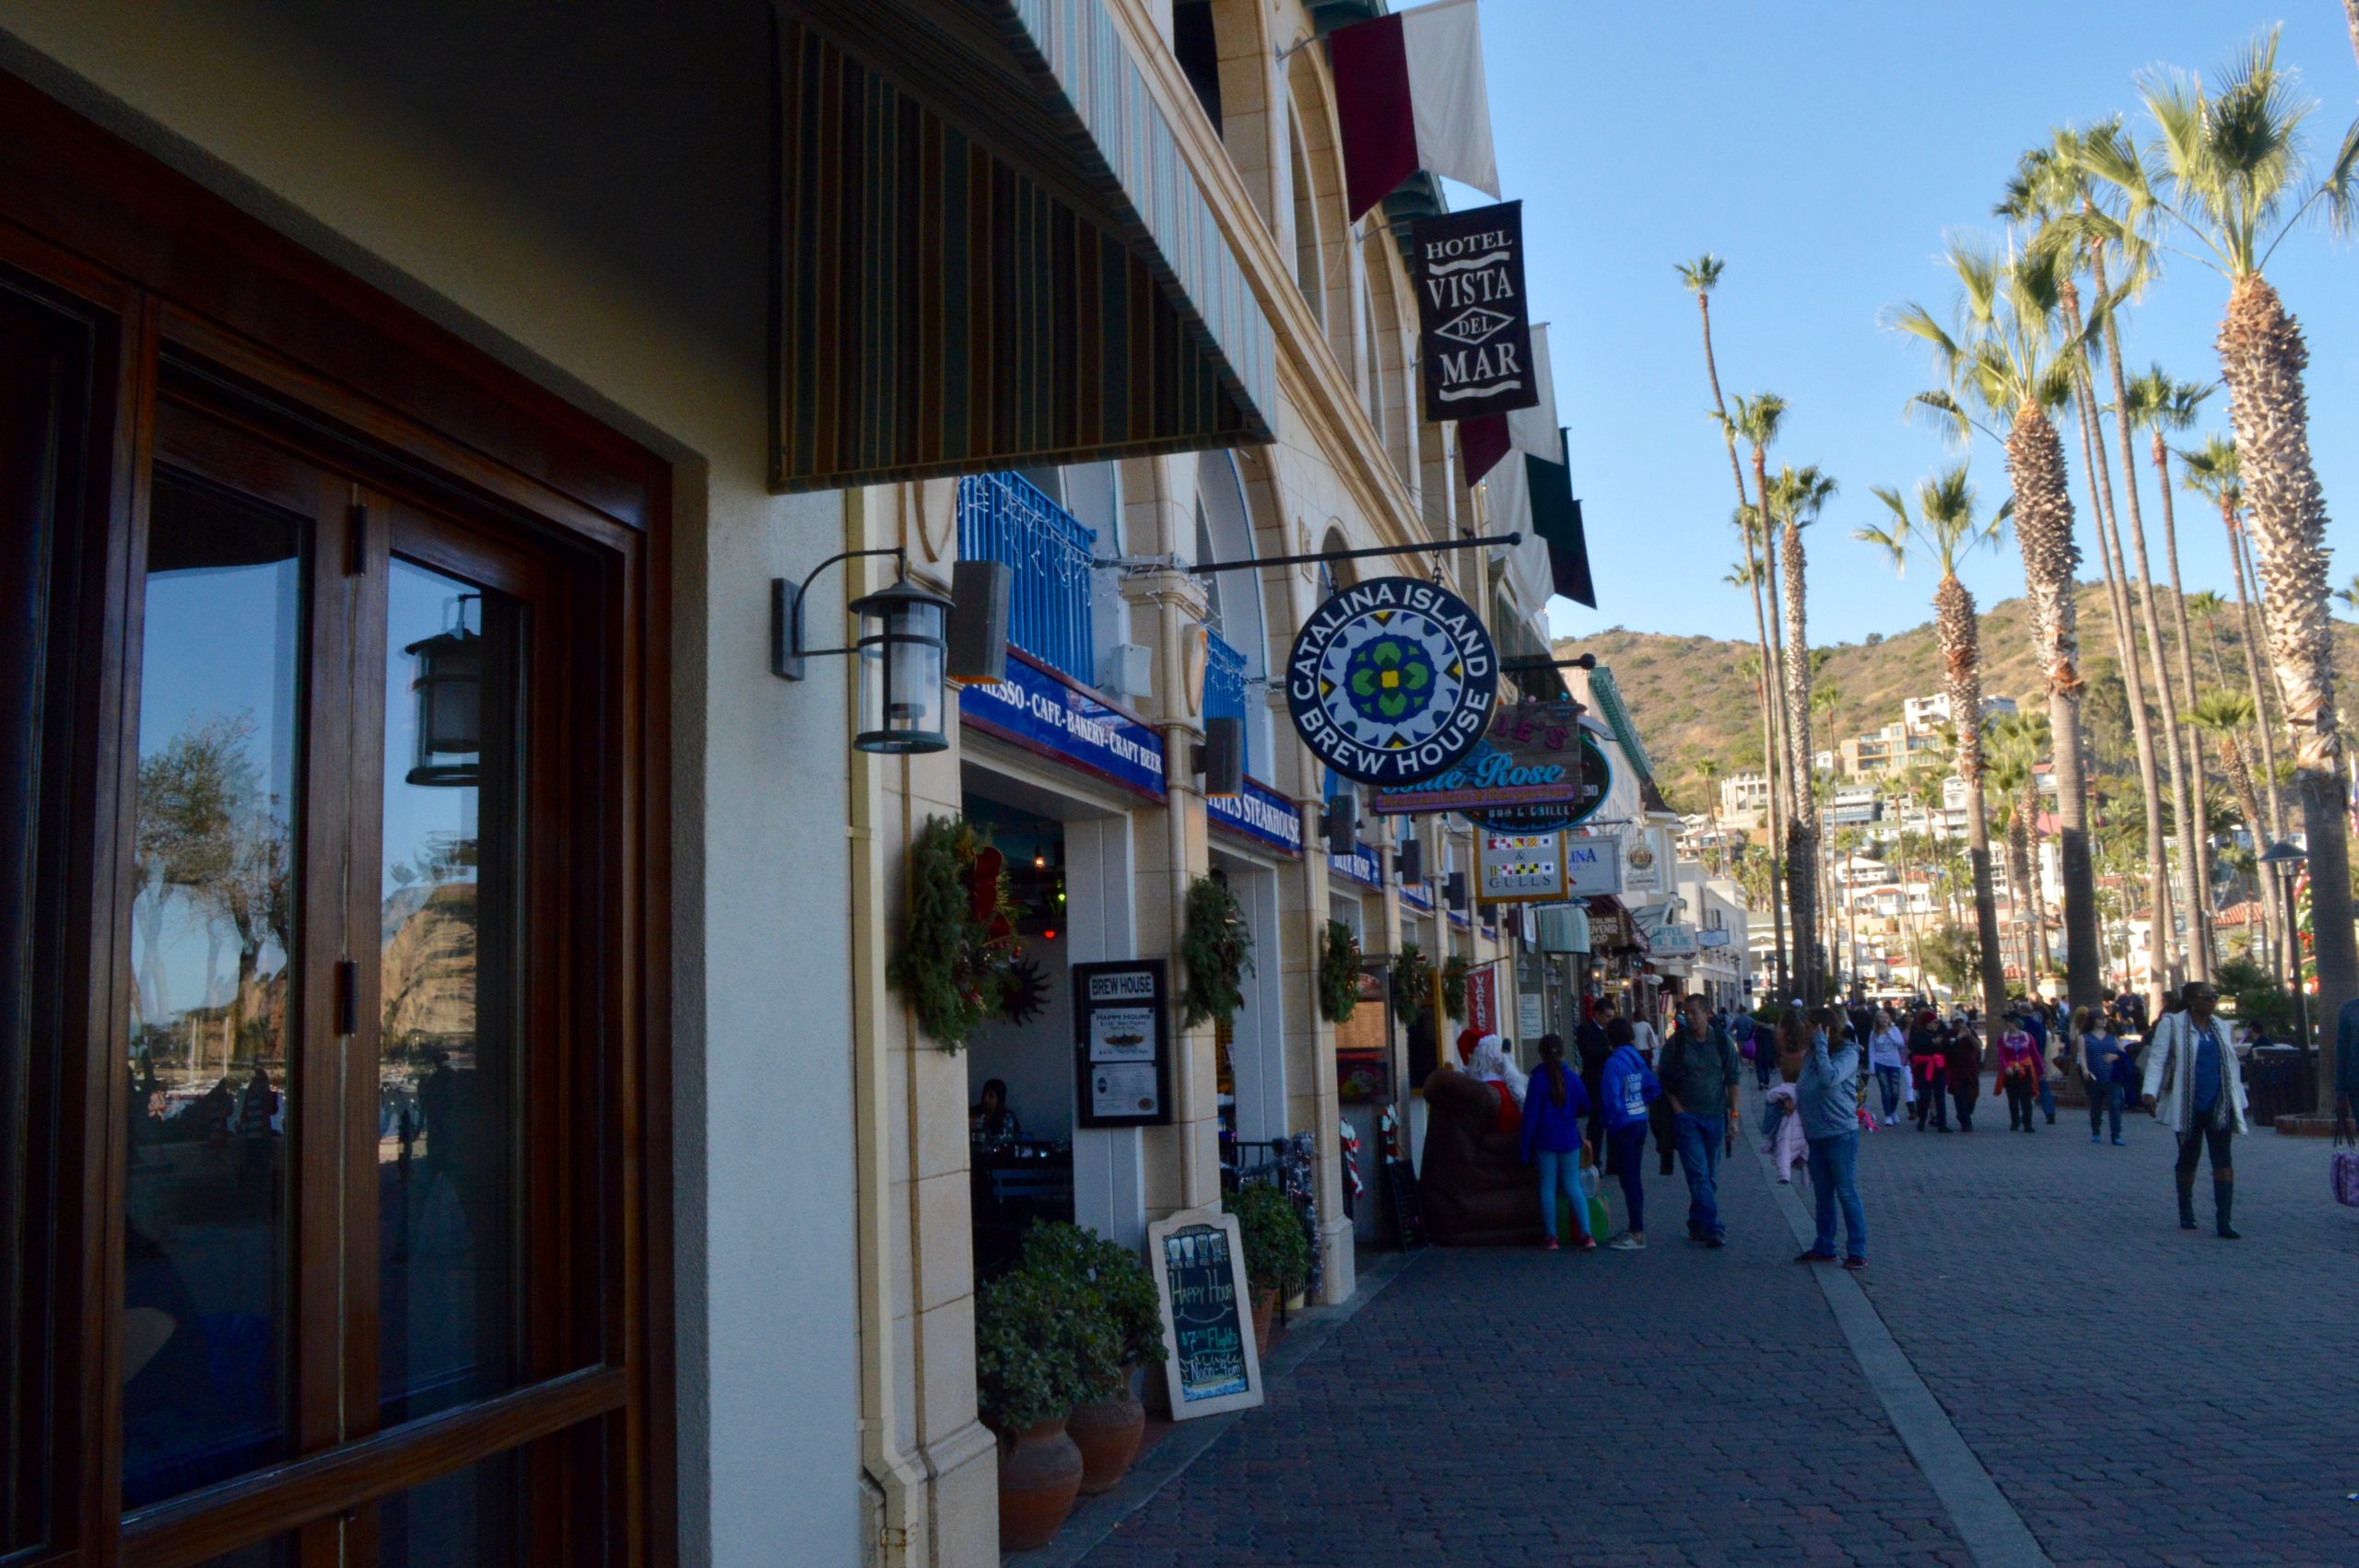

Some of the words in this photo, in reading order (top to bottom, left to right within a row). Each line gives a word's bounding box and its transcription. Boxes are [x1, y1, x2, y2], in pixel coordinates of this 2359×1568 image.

[1426, 230, 1513, 260] HOTEL
[1426, 266, 1515, 310] VISTA
[1458, 316, 1494, 337] DEL
[1439, 343, 1521, 386] MAR
[1293, 582, 1396, 701] CATALINA
[1404, 584, 1488, 678] ISLAND
[973, 680, 1025, 709] ESSO
[1032, 693, 1062, 728] CAFE
[1066, 709, 1106, 747] BAKERY
[1109, 731, 1139, 765] CRAFT
[1140, 743, 1163, 775] BEER
[1299, 707, 1387, 776] BREW
[1397, 691, 1491, 776] HOUSE
[1475, 752, 1567, 789] Rose
[1243, 792, 1300, 845] STEAKHOUSE
[1334, 854, 1353, 873] BLUE
[1353, 854, 1371, 882] ROSE
[1515, 849, 1526, 862] &
[1568, 848, 1597, 863] INA
[1489, 875, 1552, 888] GULLS
[1092, 977, 1119, 996] BREW
[1121, 976, 1152, 994] HOUSE
[1207, 1326, 1238, 1351] Flights
